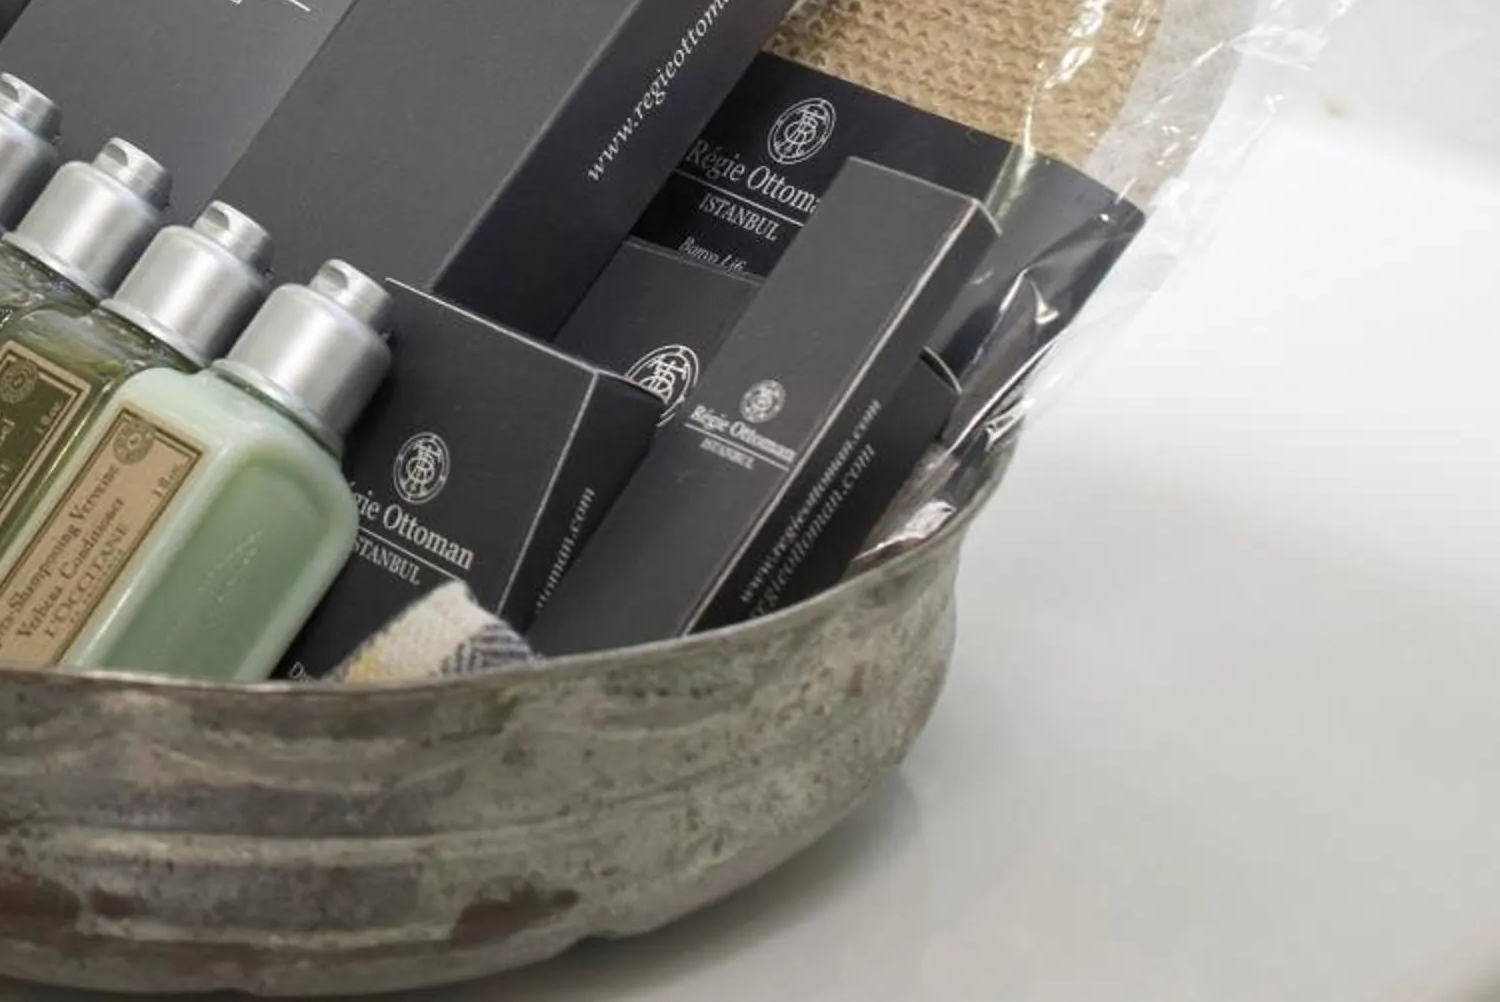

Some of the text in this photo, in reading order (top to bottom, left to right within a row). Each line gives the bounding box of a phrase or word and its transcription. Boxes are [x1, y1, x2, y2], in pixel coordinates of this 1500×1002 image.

[686, 139, 821, 214] Régie Ottom
[68, 463, 122, 523] Verveine
[15, 586, 64, 639] Verbena
[59, 497, 126, 581] Conditioner
[353, 535, 422, 586] STANBUL
[382, 503, 476, 571] Ottoman
